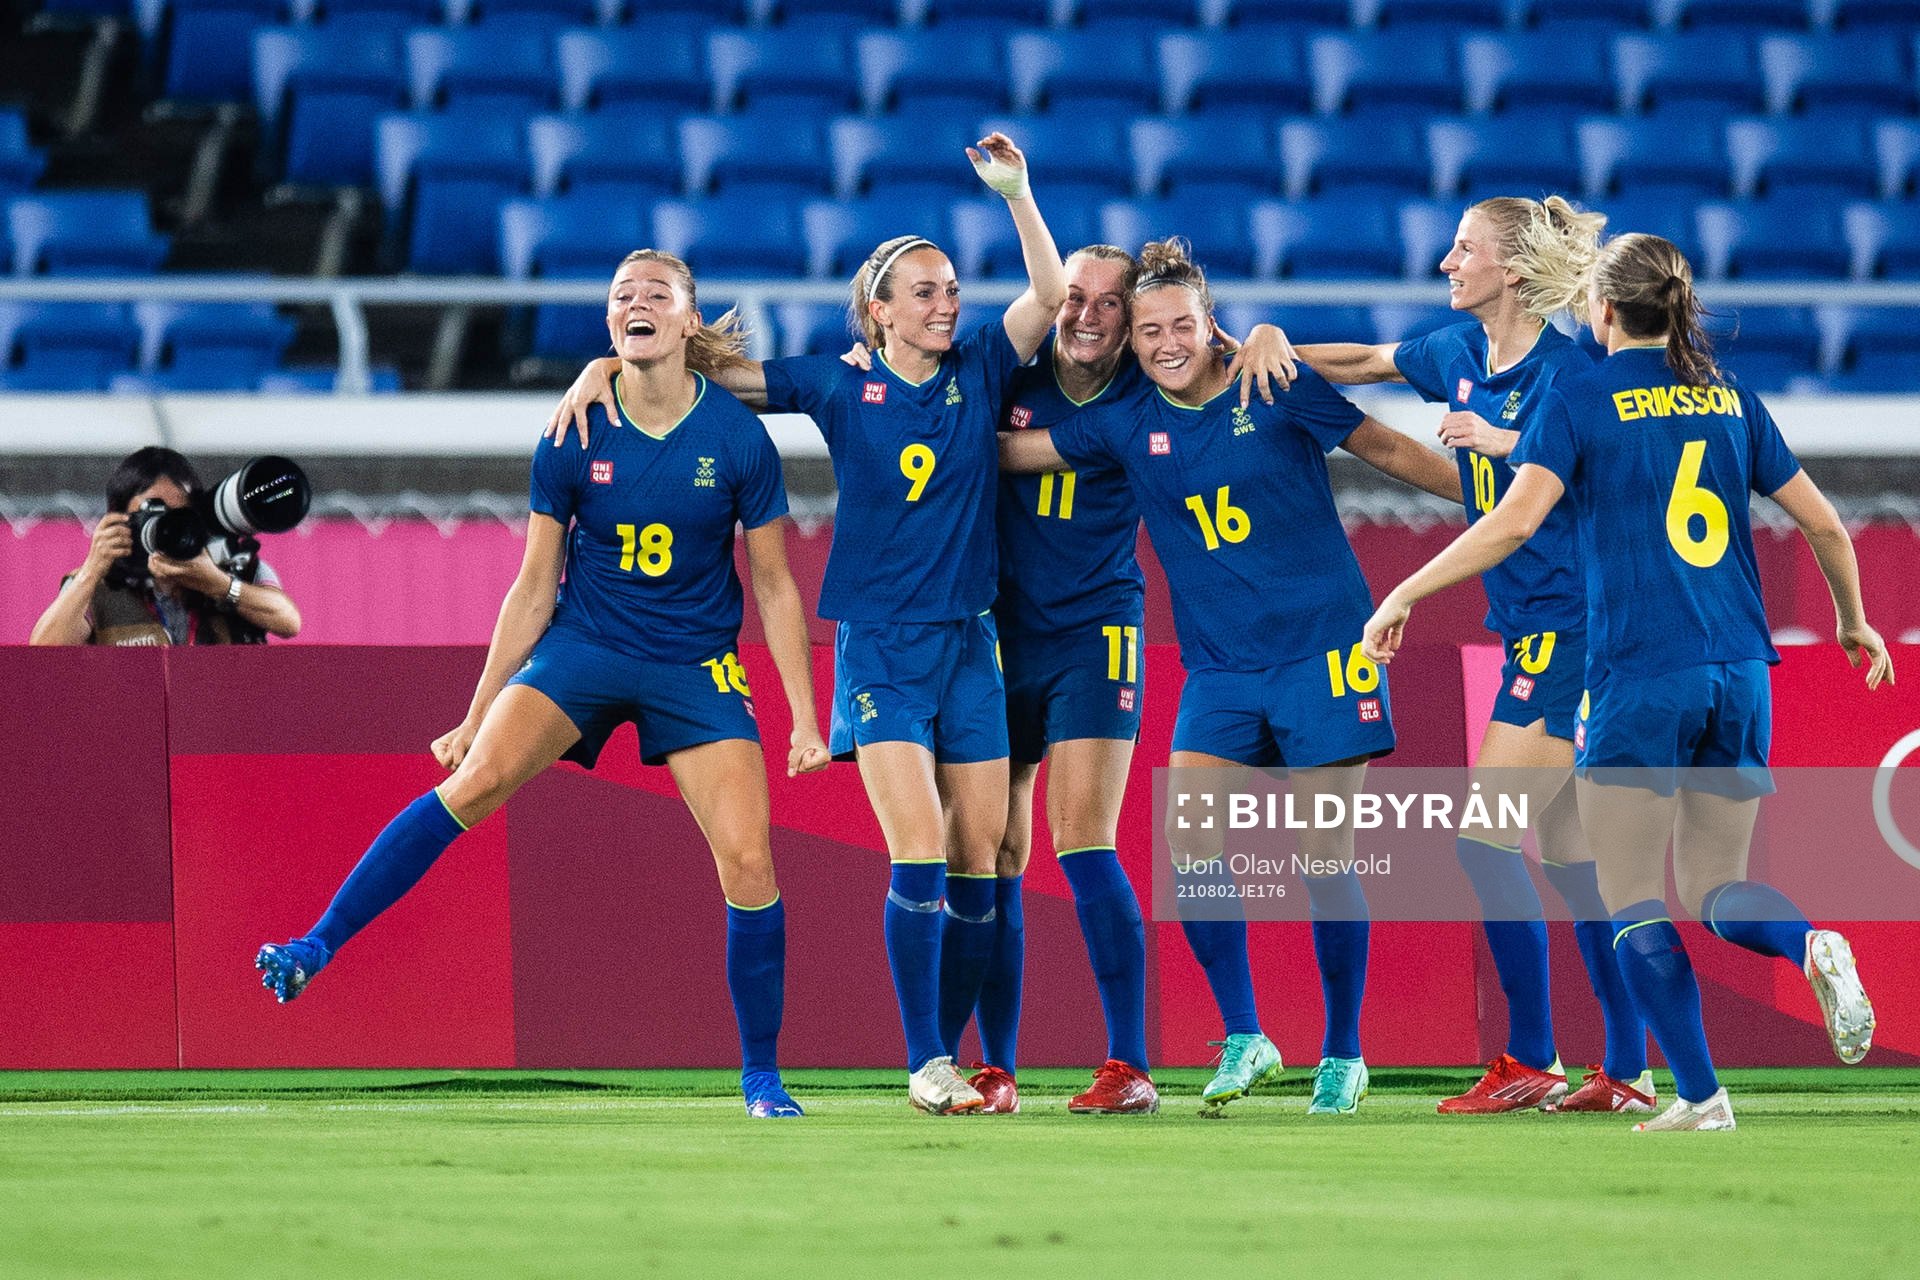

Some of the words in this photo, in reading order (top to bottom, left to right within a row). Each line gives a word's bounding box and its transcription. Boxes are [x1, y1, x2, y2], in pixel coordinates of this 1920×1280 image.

[866, 383, 883, 392] UNI
[864, 392, 883, 401] QLO
[1612, 385, 1743, 422] ERIKSSON
[1012, 406, 1029, 420] UNI
[1010, 415, 1027, 427] QLO
[1233, 422, 1256, 437] SWE
[1151, 434, 1168, 443] UNI
[1151, 443, 1169, 453] QLO
[593, 463, 610, 472] UNI
[900, 443, 936, 502] 9
[592, 472, 611, 482] QLO
[694, 478, 716, 488] SWE
[1469, 451, 1495, 514] 10
[1037, 470, 1077, 520] 11
[1666, 440, 1729, 568] 6
[1185, 485, 1251, 551] 16
[616, 523, 674, 578] 18
[1102, 626, 1137, 683] 11
[1326, 641, 1380, 698] 16
[1516, 677, 1531, 688] UNI
[1513, 685, 1529, 697] QLO
[1360, 701, 1377, 711] UNI
[1361, 710, 1379, 721] QLO
